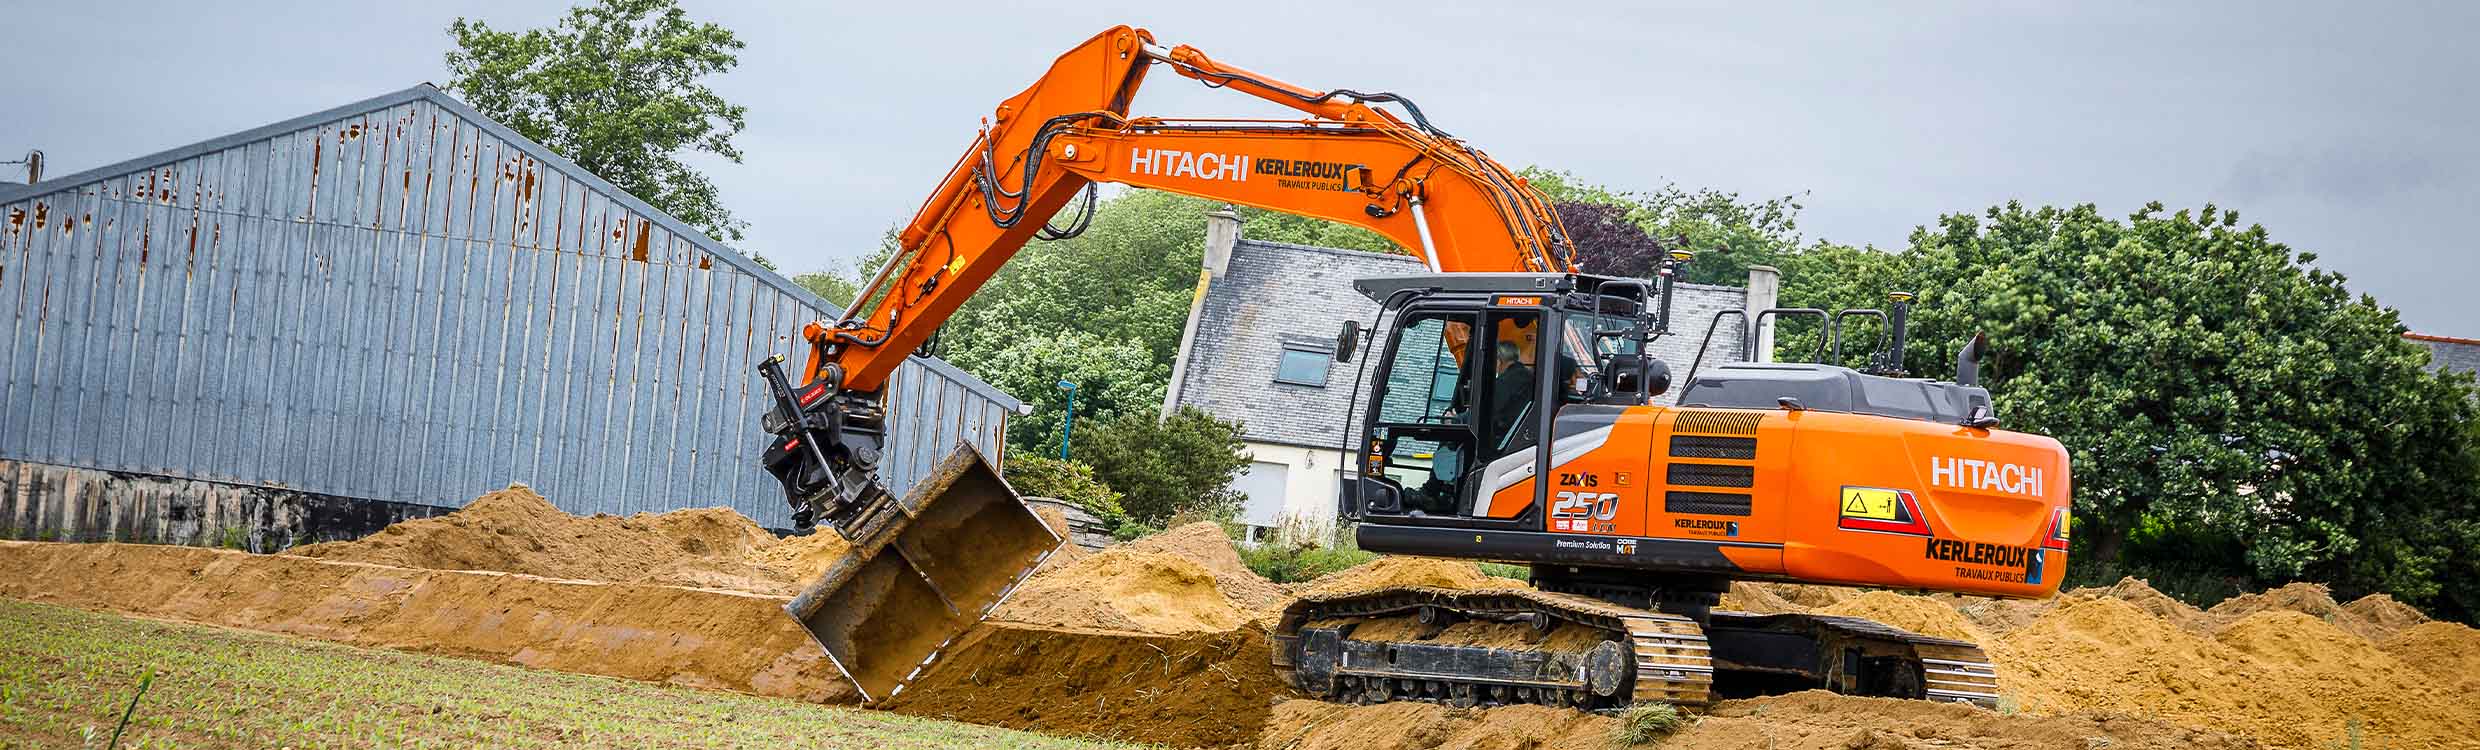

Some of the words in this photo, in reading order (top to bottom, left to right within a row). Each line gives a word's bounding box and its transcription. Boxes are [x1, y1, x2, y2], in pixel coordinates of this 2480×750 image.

[1130, 148, 1249, 181] HITACHI
[1255, 158, 1343, 179] KERLEROUX
[1278, 179, 1310, 190] TRAVAUX
[1312, 181, 1342, 192] PUBLICS
[1560, 472, 1598, 487] ZAXIS
[1932, 456, 2042, 496] HITACHI
[1551, 491, 1619, 520] 250
[1674, 518, 1726, 529] KERLEROUX
[1556, 540, 1584, 548] Premium
[1585, 541, 1611, 550] Solution
[1616, 544, 1637, 555] MAT
[1926, 538, 2026, 568] KERLEROUX
[1955, 567, 1994, 581] TRAVAUX
[1995, 571, 2024, 584] PUBLICS
